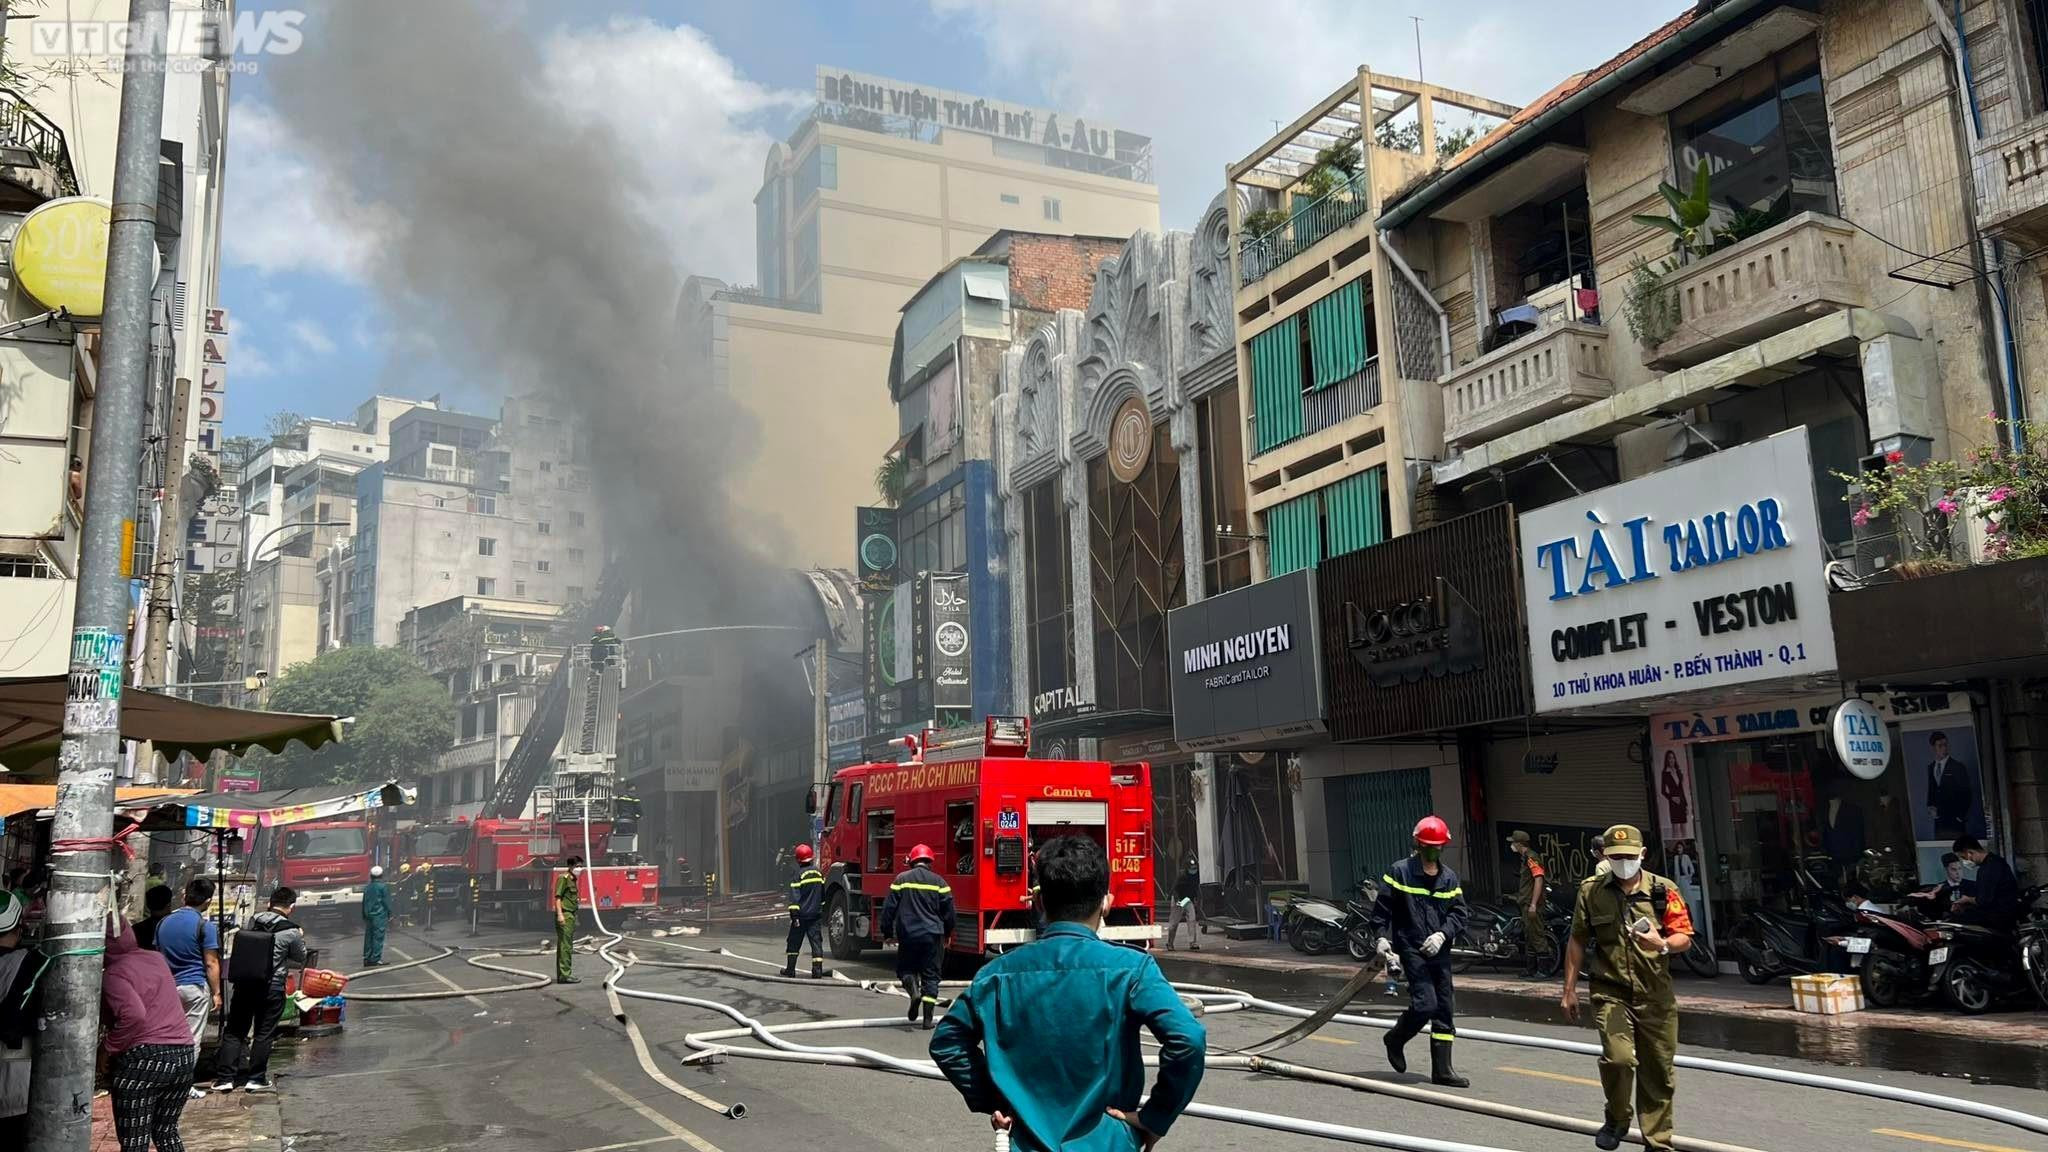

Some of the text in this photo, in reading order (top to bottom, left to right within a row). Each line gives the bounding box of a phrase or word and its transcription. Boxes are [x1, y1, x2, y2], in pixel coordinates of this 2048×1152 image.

[825, 74, 883, 110] BỆNH
[889, 88, 937, 121] VIỆN
[1005, 110, 1033, 139] MỸ
[1537, 498, 1792, 600] TÀI TAILOR
[915, 580, 923, 680] CUISINE
[1550, 613, 1648, 662] COMPLET
[1692, 582, 1798, 637] VESTON
[868, 601, 876, 695] MALAYSIAN
[1183, 624, 1290, 674] MINH NGUYEN
[1552, 681, 1566, 697] 10
[1568, 672, 1591, 695] THỦ
[1594, 673, 1626, 693] KHOA
[1628, 664, 1661, 687] HUÂN
[1715, 646, 1764, 672] THÀNH
[1034, 685, 1085, 715] CAPITAL
[1663, 712, 1729, 741] TÀI
[1736, 708, 1800, 732] TAILOR
[1844, 708, 1880, 736] TÀI
[1849, 741, 1884, 752] TAILOR
[868, 772, 894, 793] PCCC
[928, 760, 947, 787] CHÍ
[948, 761, 977, 785] MINH
[1043, 785, 1093, 798] Camiva
[1000, 820, 1017, 828] 0248
[1002, 812, 1015, 821] 51F
[1115, 839, 1136, 853] 51F
